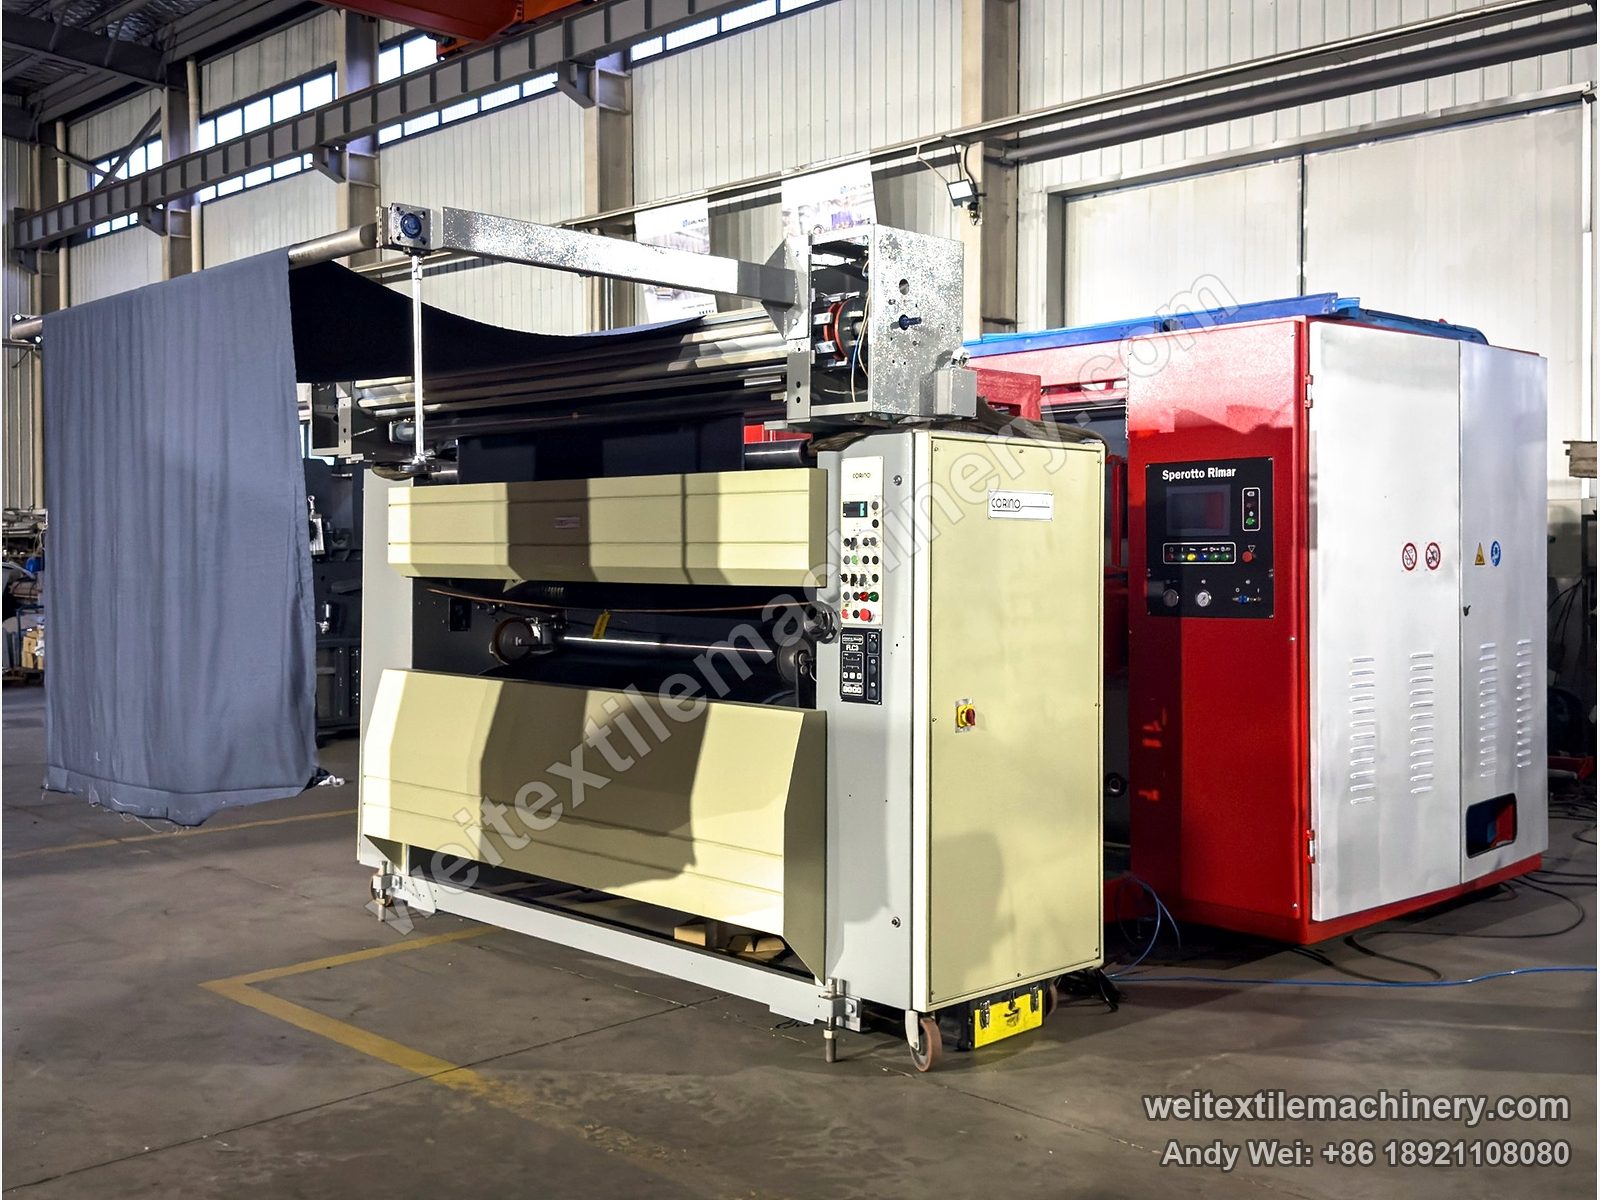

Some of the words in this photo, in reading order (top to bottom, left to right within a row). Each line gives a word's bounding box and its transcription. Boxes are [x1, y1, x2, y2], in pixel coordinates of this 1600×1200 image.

[1162, 468, 1205, 482] Sperotto
[1207, 467, 1236, 478] Rimar
[991, 498, 1021, 509] CORINO
